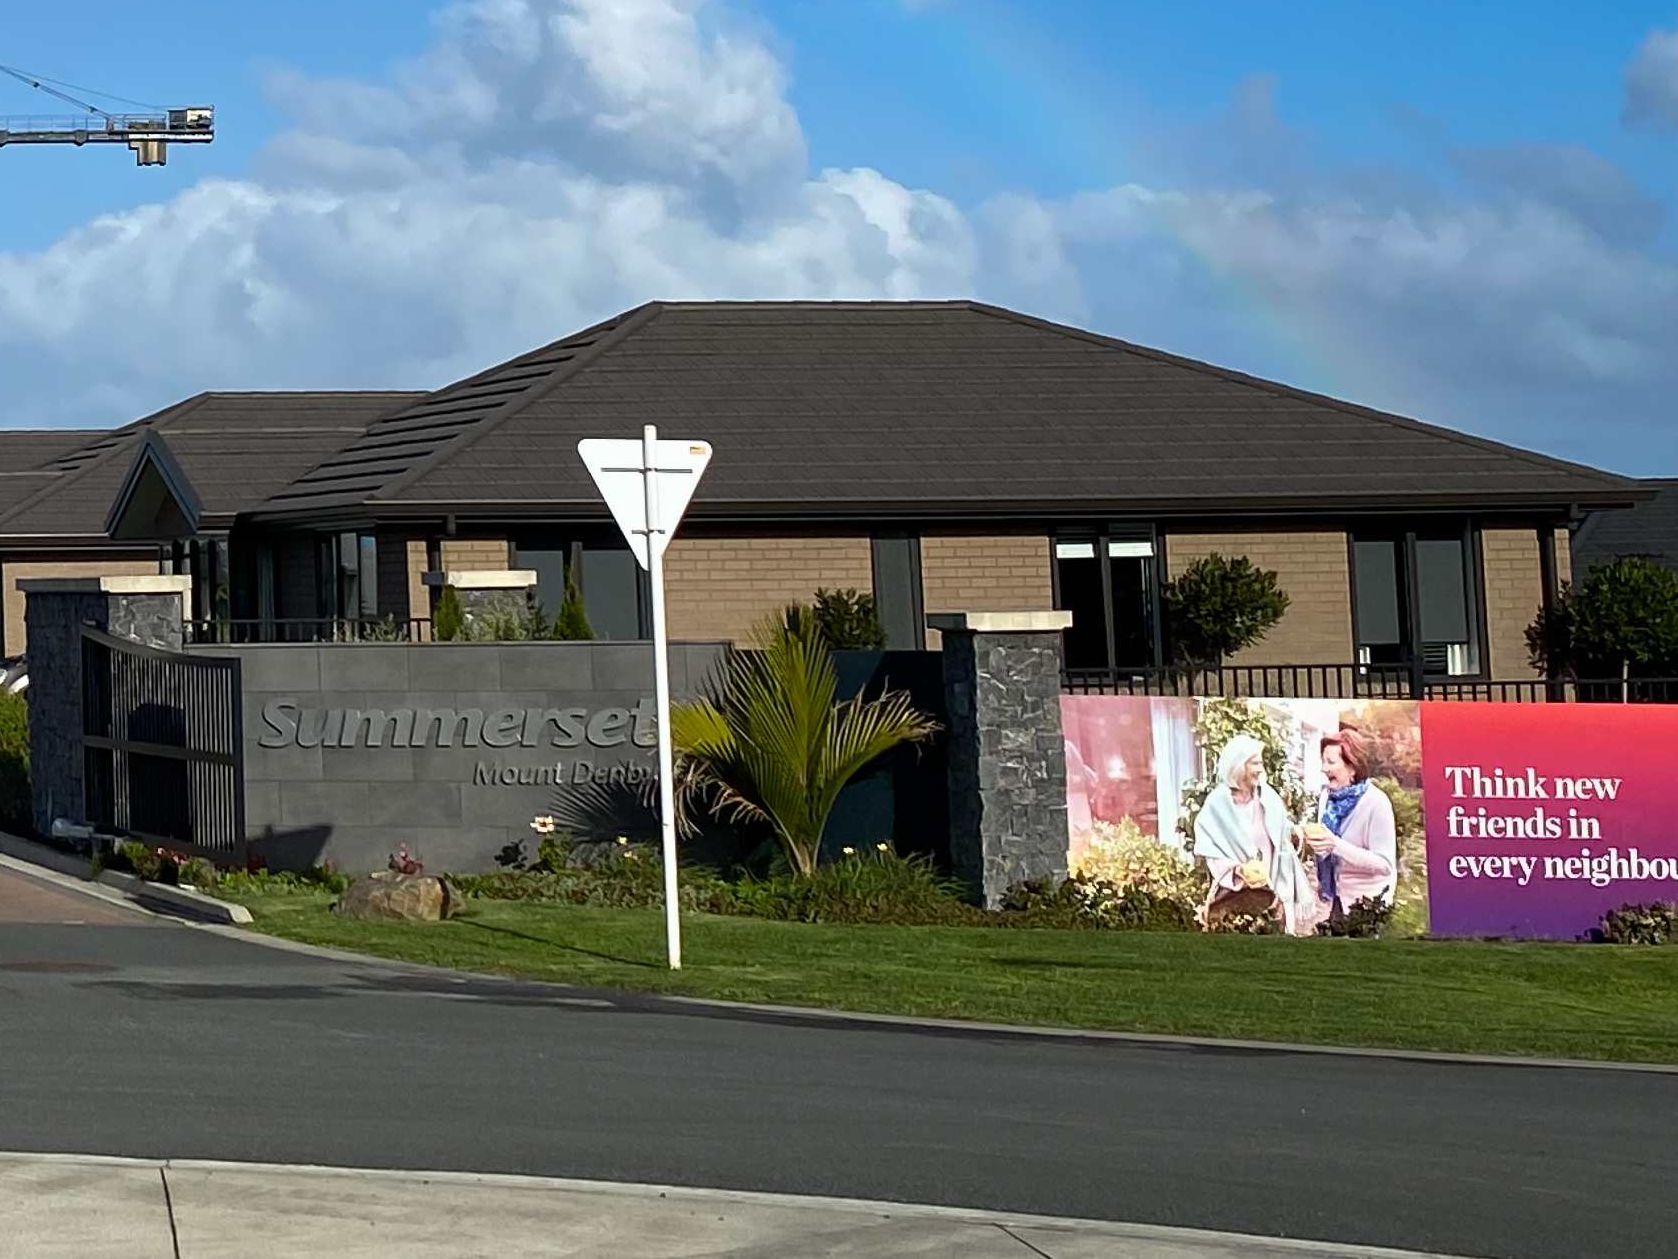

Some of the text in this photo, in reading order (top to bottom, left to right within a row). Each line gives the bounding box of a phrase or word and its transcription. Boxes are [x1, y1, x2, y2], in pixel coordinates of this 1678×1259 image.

[257, 696, 656, 749] Summerset
[473, 760, 564, 786] Mount
[1445, 766, 1622, 799] Think new
[1446, 805, 1602, 840] friends in
[1449, 854, 1538, 886] every
